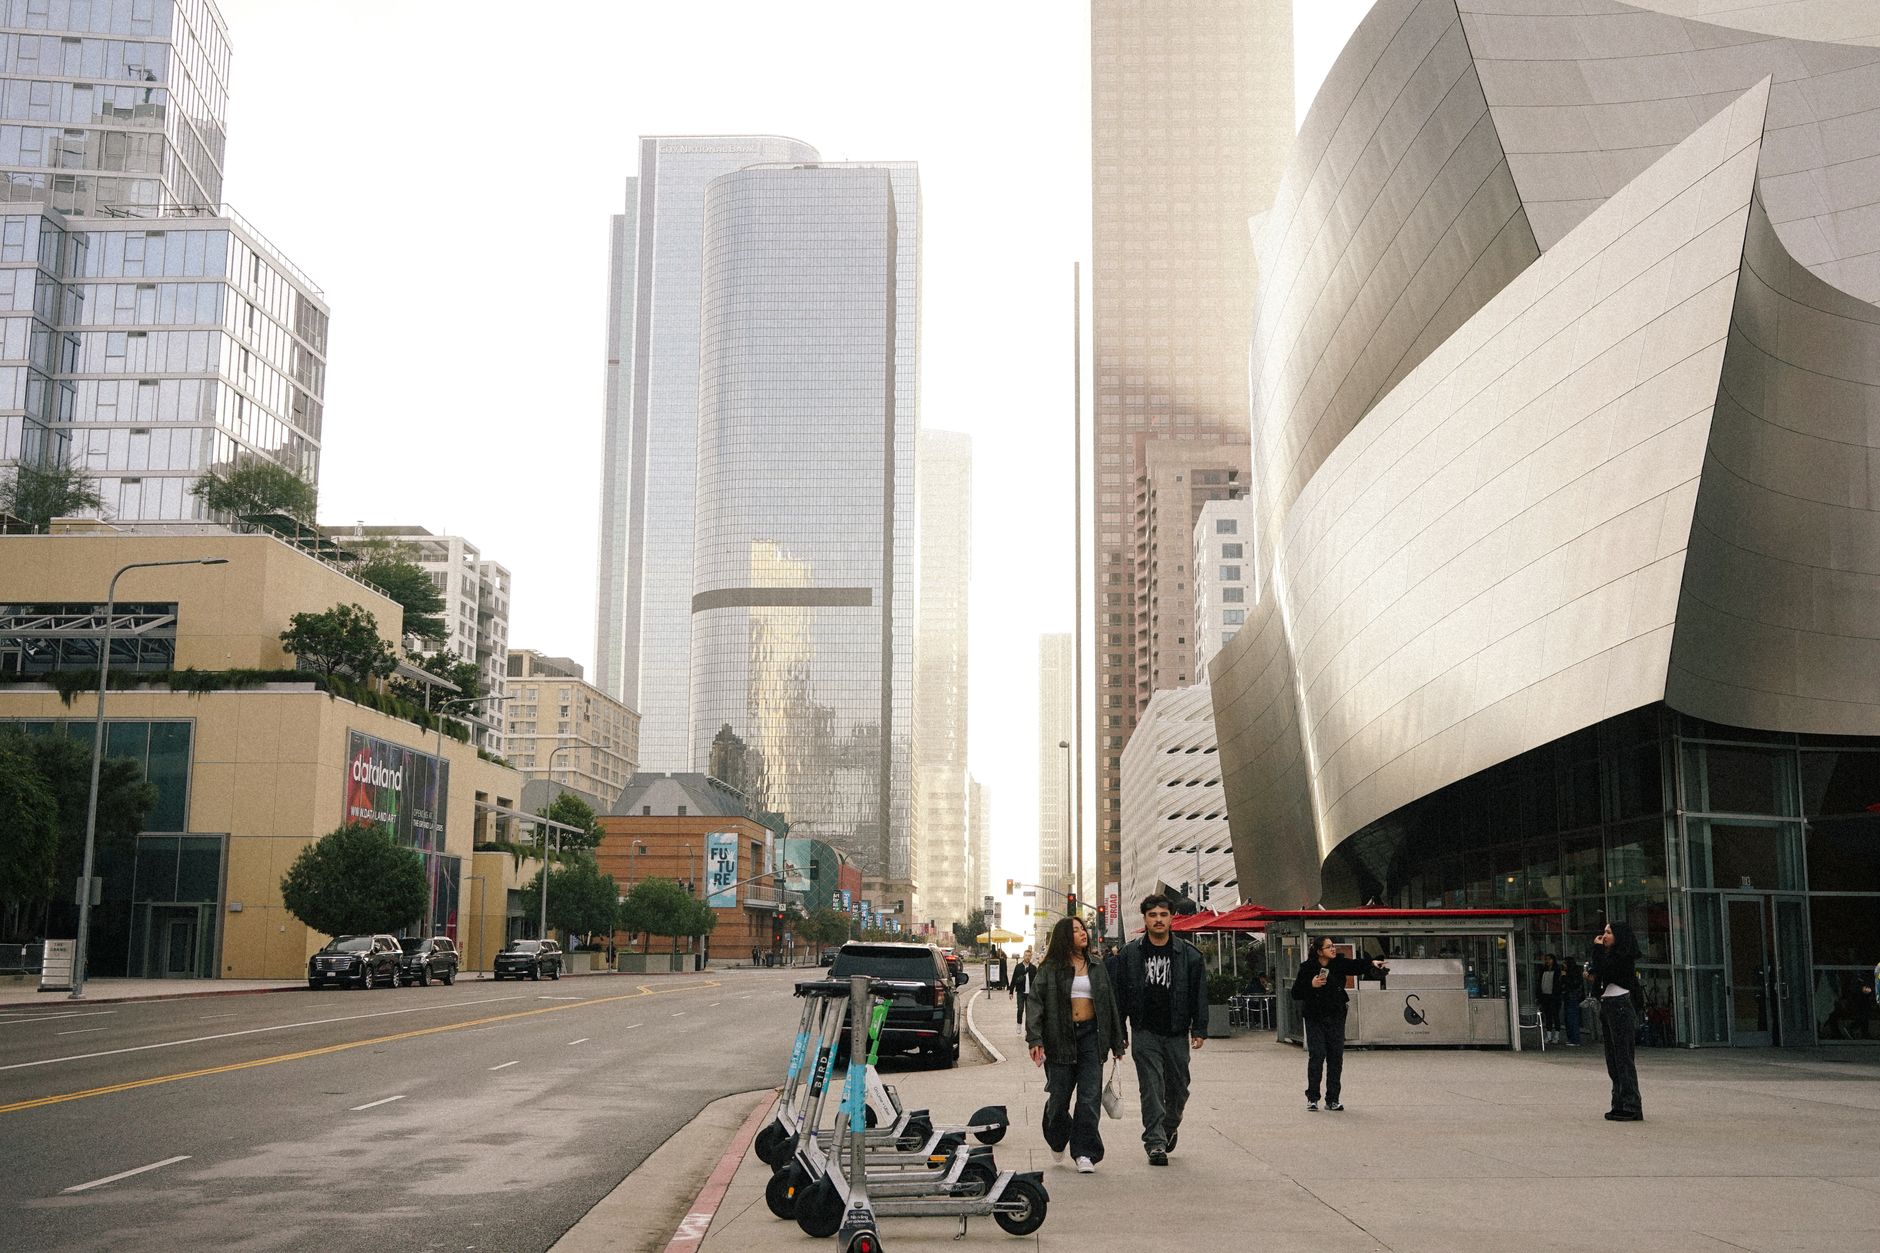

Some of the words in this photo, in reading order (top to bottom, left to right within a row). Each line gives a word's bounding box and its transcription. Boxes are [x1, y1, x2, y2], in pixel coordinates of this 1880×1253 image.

[353, 754, 403, 791] dataland
[711, 848, 728, 860] FU
[718, 861, 734, 873] TU
[714, 873, 731, 886] RE
[814, 1056, 828, 1088] BIRD
